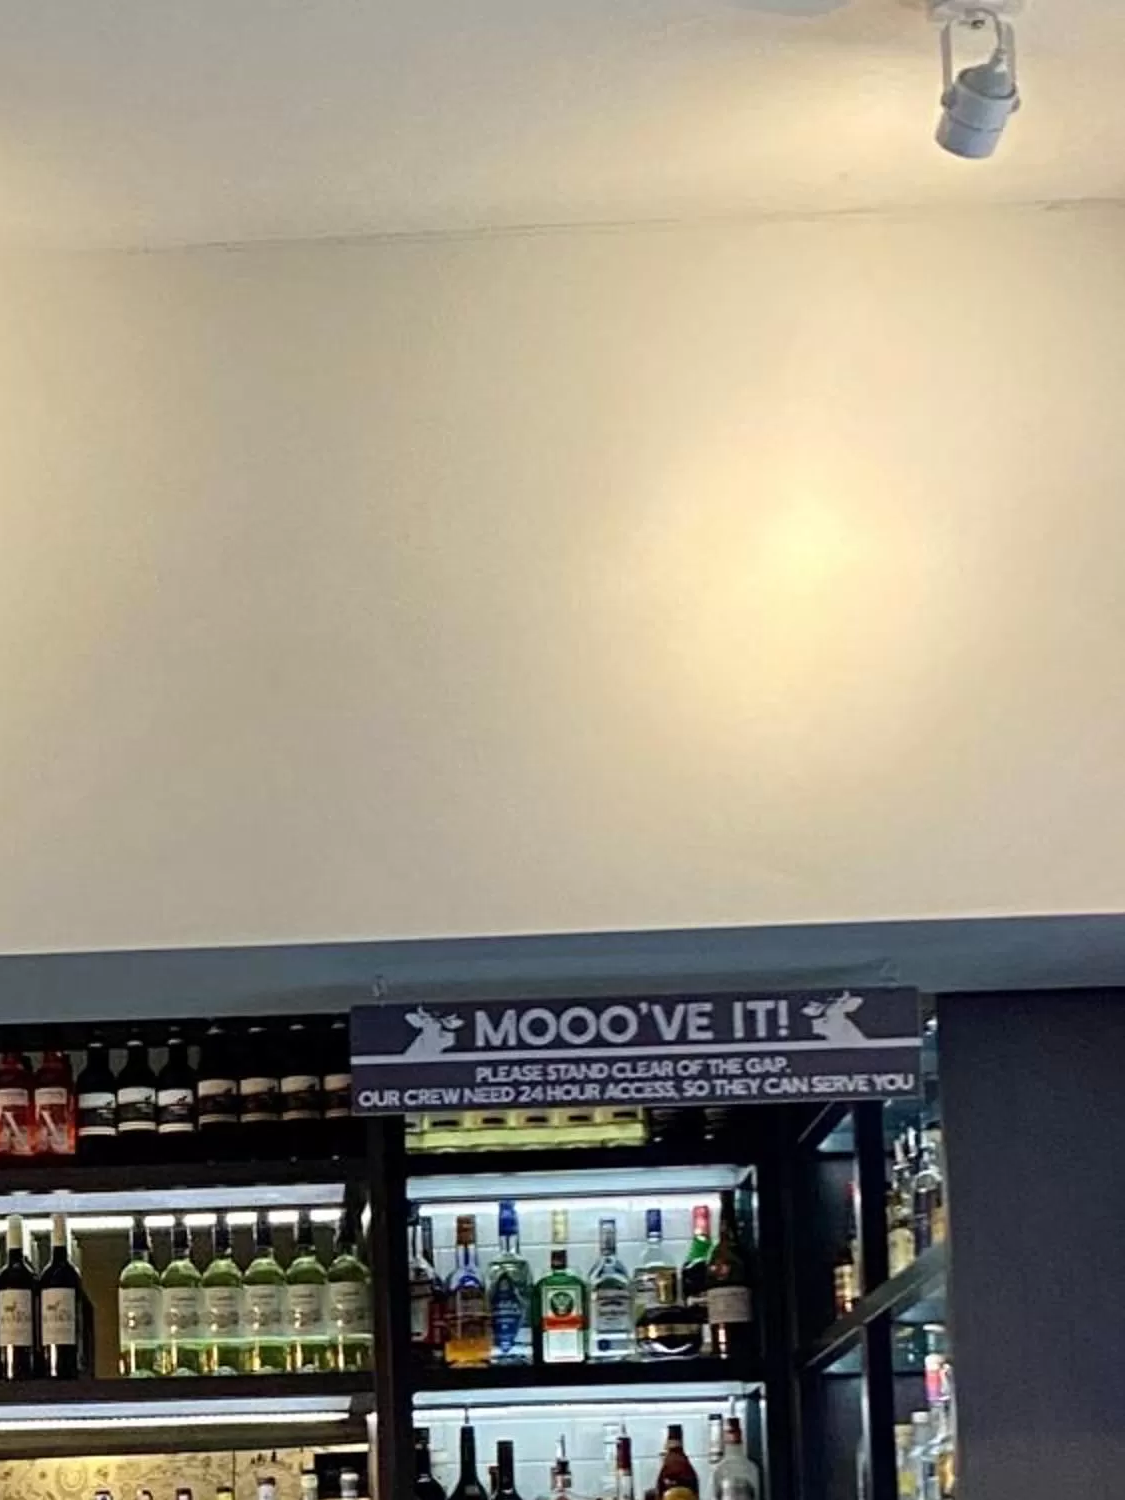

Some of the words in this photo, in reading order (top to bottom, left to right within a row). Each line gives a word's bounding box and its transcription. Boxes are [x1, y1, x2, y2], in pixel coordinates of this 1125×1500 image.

[475, 1002, 714, 1048] MOOO'VE
[732, 999, 789, 1039] IT!
[475, 1063, 544, 1083] PLEASE
[546, 1061, 608, 1082] STAND
[611, 1058, 674, 1081] CLEAR
[676, 1057, 704, 1077] OF
[707, 1056, 743, 1075] THE
[745, 1054, 792, 1074] GAP.
[358, 1089, 400, 1108] OUR
[403, 1087, 462, 1107] CREW
[463, 1085, 516, 1104] NEED
[518, 1084, 544, 1102] 24
[546, 1082, 601, 1102] HOUR
[682, 1078, 709, 1097] SO
[712, 1076, 762, 1096] THEY
[763, 1075, 809, 1094] CAN
[810, 1073, 869, 1093] SERVE
[871, 1072, 915, 1091] YOU
